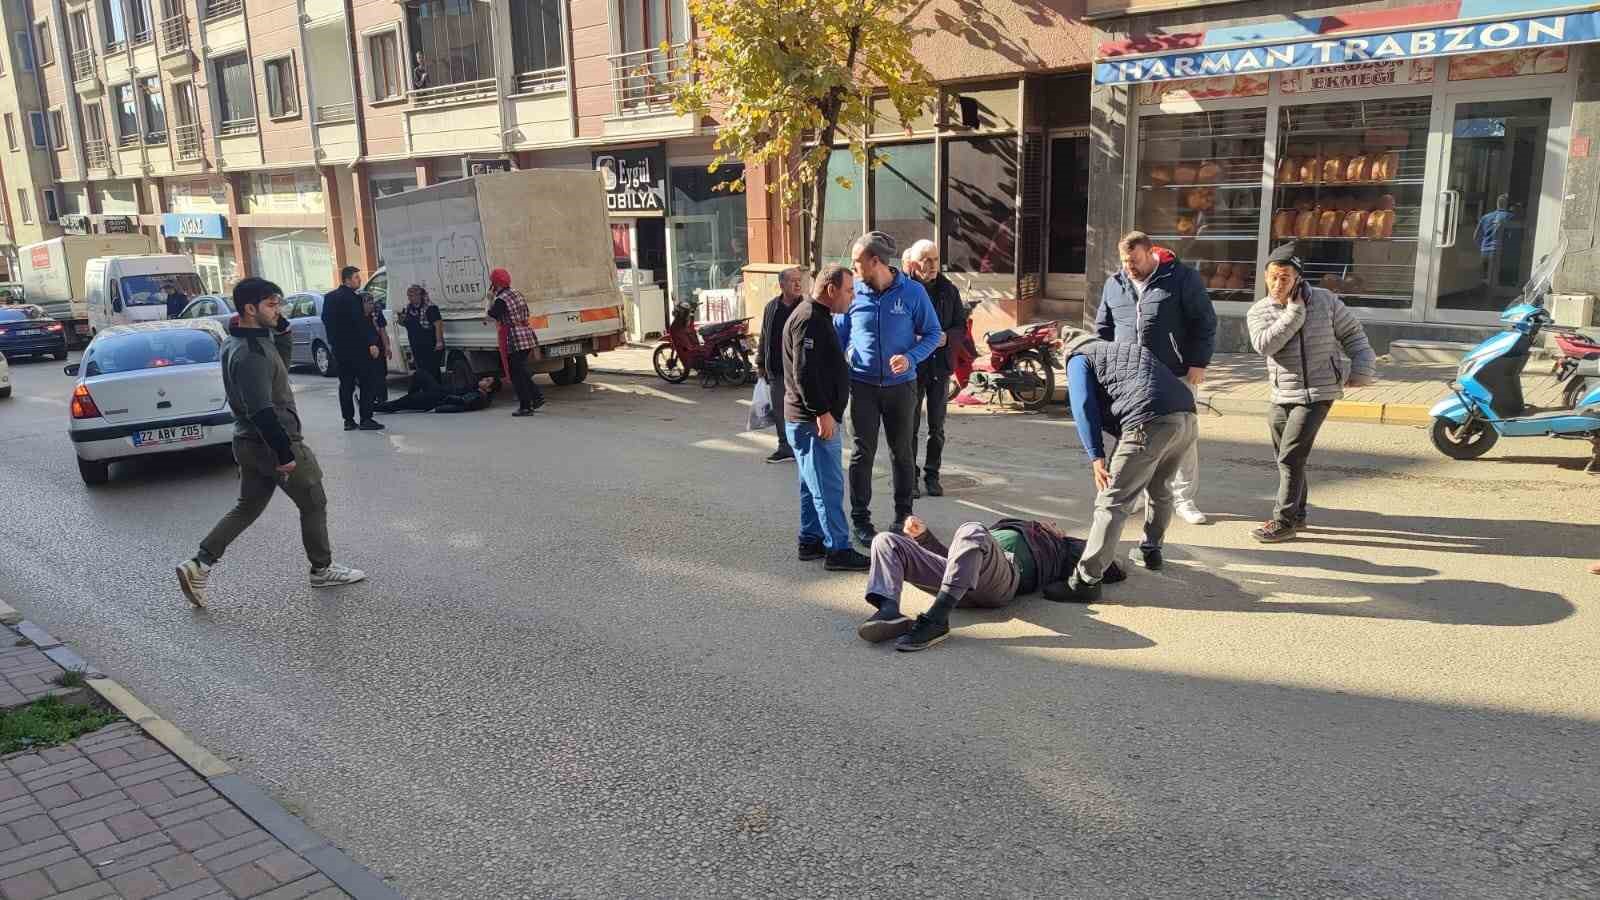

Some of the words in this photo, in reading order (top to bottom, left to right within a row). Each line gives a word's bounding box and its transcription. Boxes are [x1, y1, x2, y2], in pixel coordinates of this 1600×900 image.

[1118, 45, 1296, 82] HARMAN
[1312, 16, 1566, 62] TRABZON
[619, 157, 650, 188] Eygül
